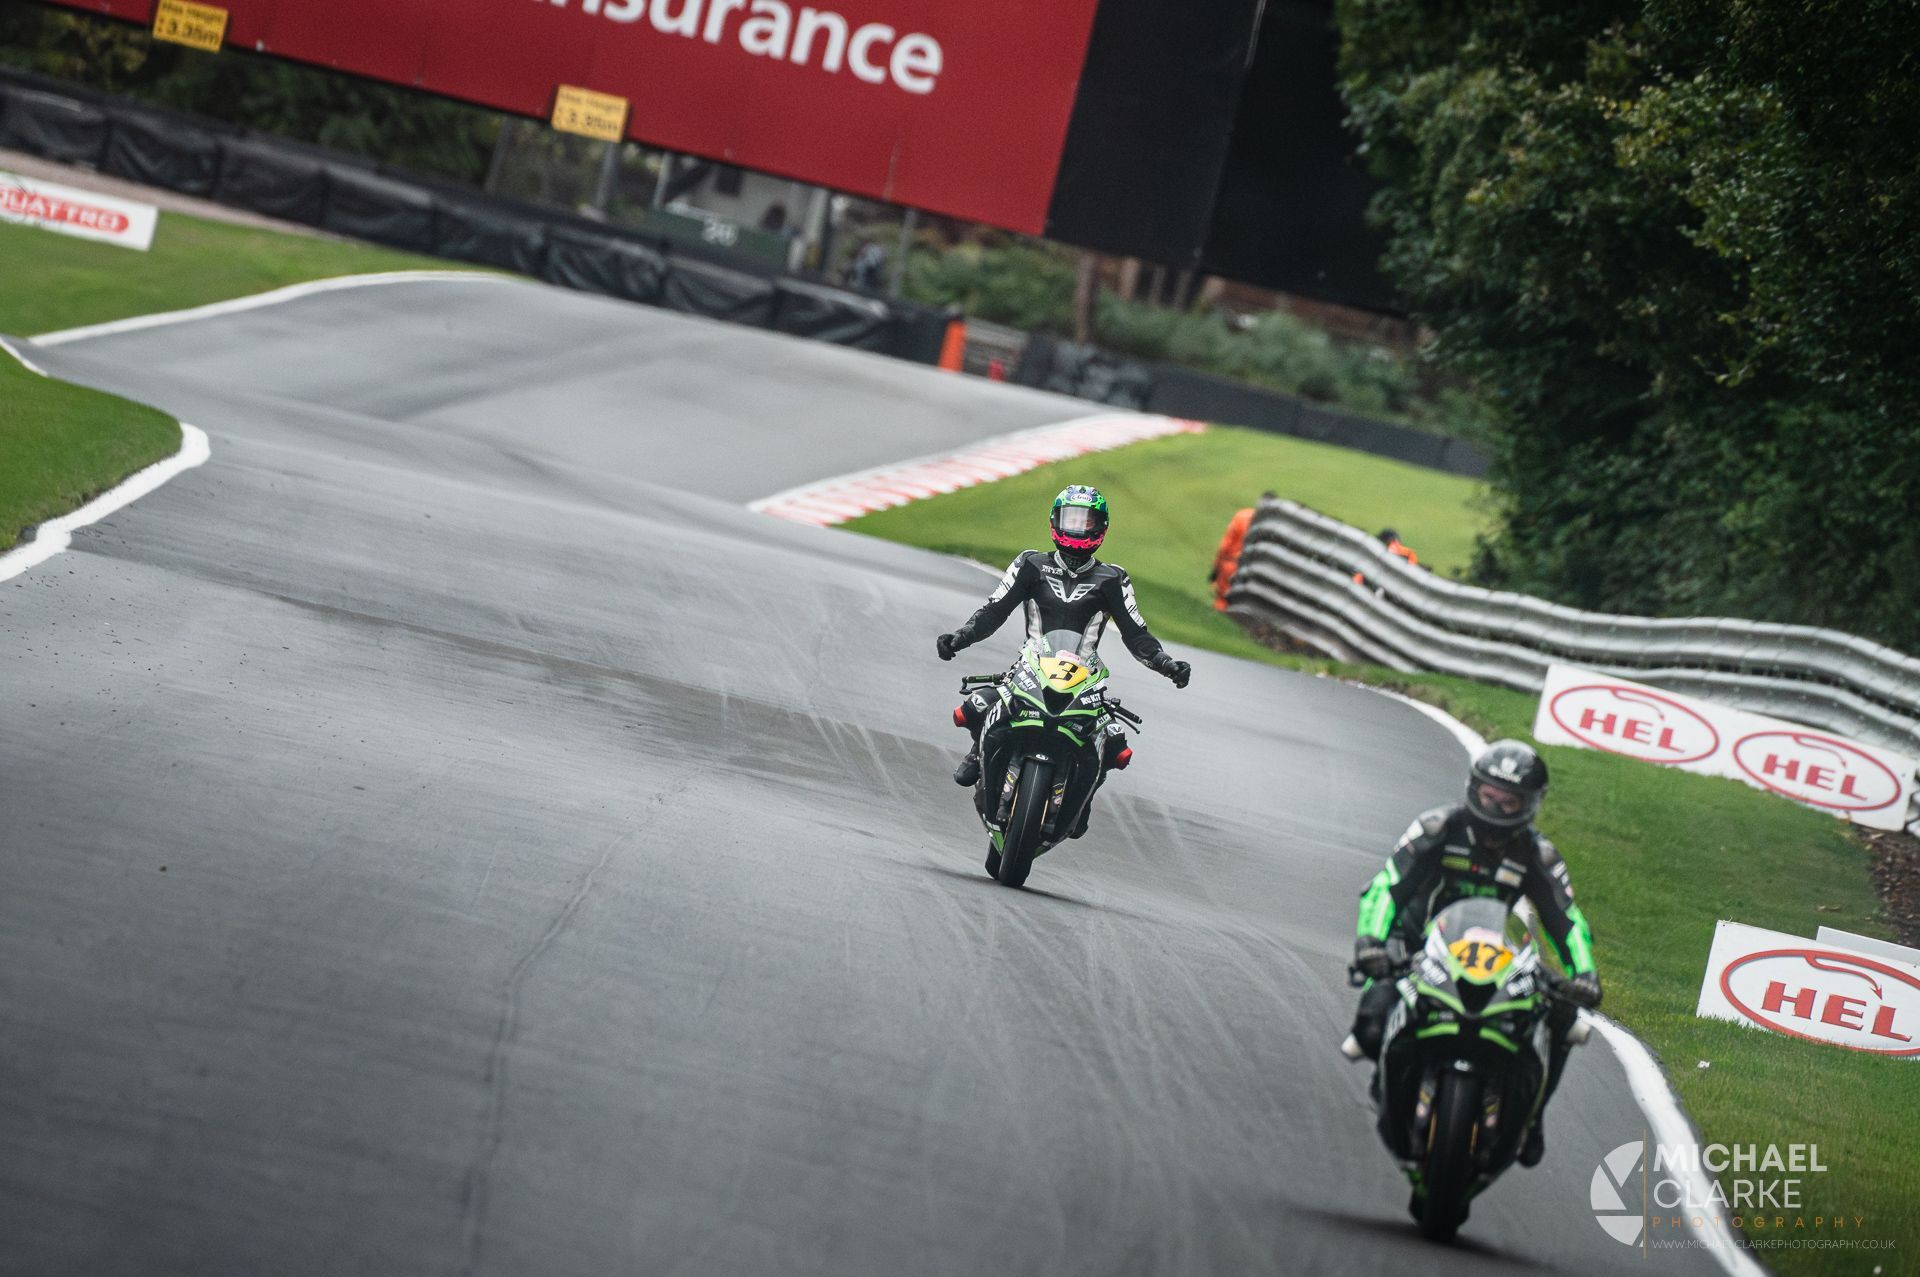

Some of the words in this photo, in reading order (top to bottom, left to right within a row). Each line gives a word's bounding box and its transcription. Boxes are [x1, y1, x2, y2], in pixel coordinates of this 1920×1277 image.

[533, 0, 944, 94] urance
[1049, 660, 1078, 681] 3
[1579, 708, 1685, 753] HEL
[1762, 753, 1867, 801] HEL
[1456, 942, 1505, 970] 47
[1761, 980, 1912, 1042] HEL
